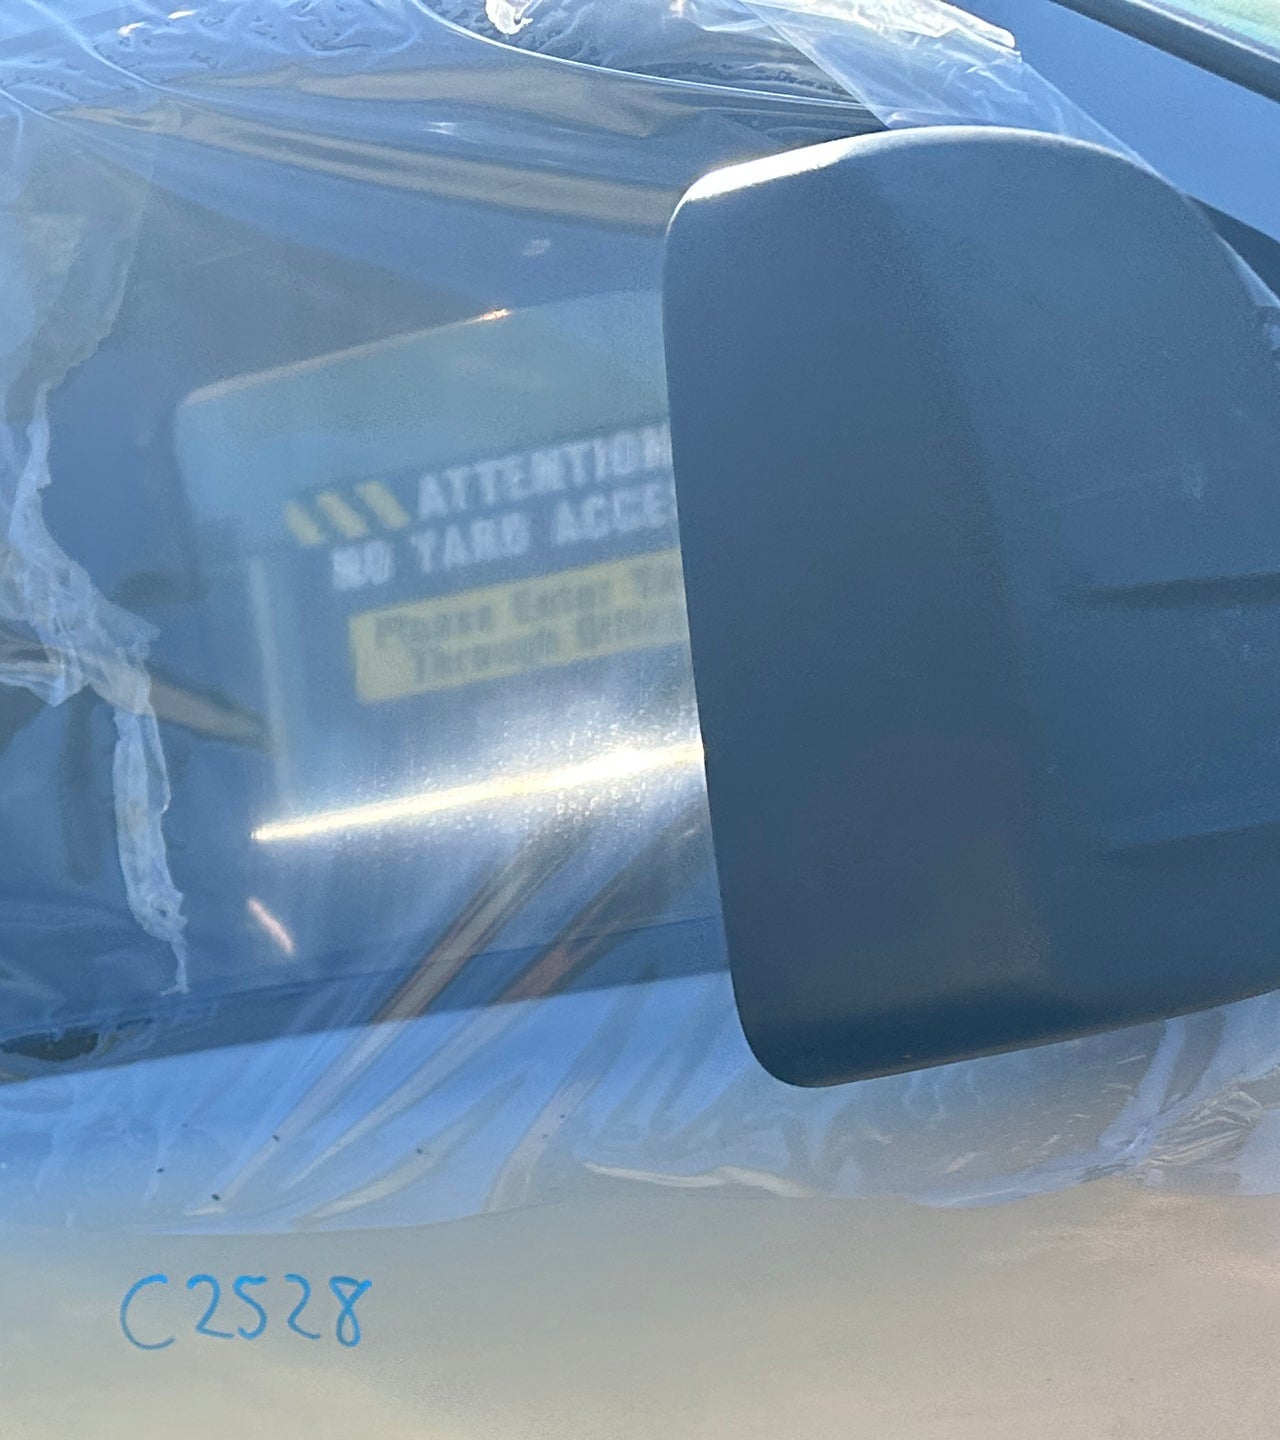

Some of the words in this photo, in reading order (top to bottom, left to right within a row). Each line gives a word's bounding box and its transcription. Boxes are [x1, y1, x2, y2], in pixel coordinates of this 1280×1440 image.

[417, 424, 672, 522] ATTENTION
[333, 538, 395, 591] NO
[410, 511, 532, 574] YARD
[550, 481, 677, 547] ACCE
[119, 1272, 373, 1350] C2528
